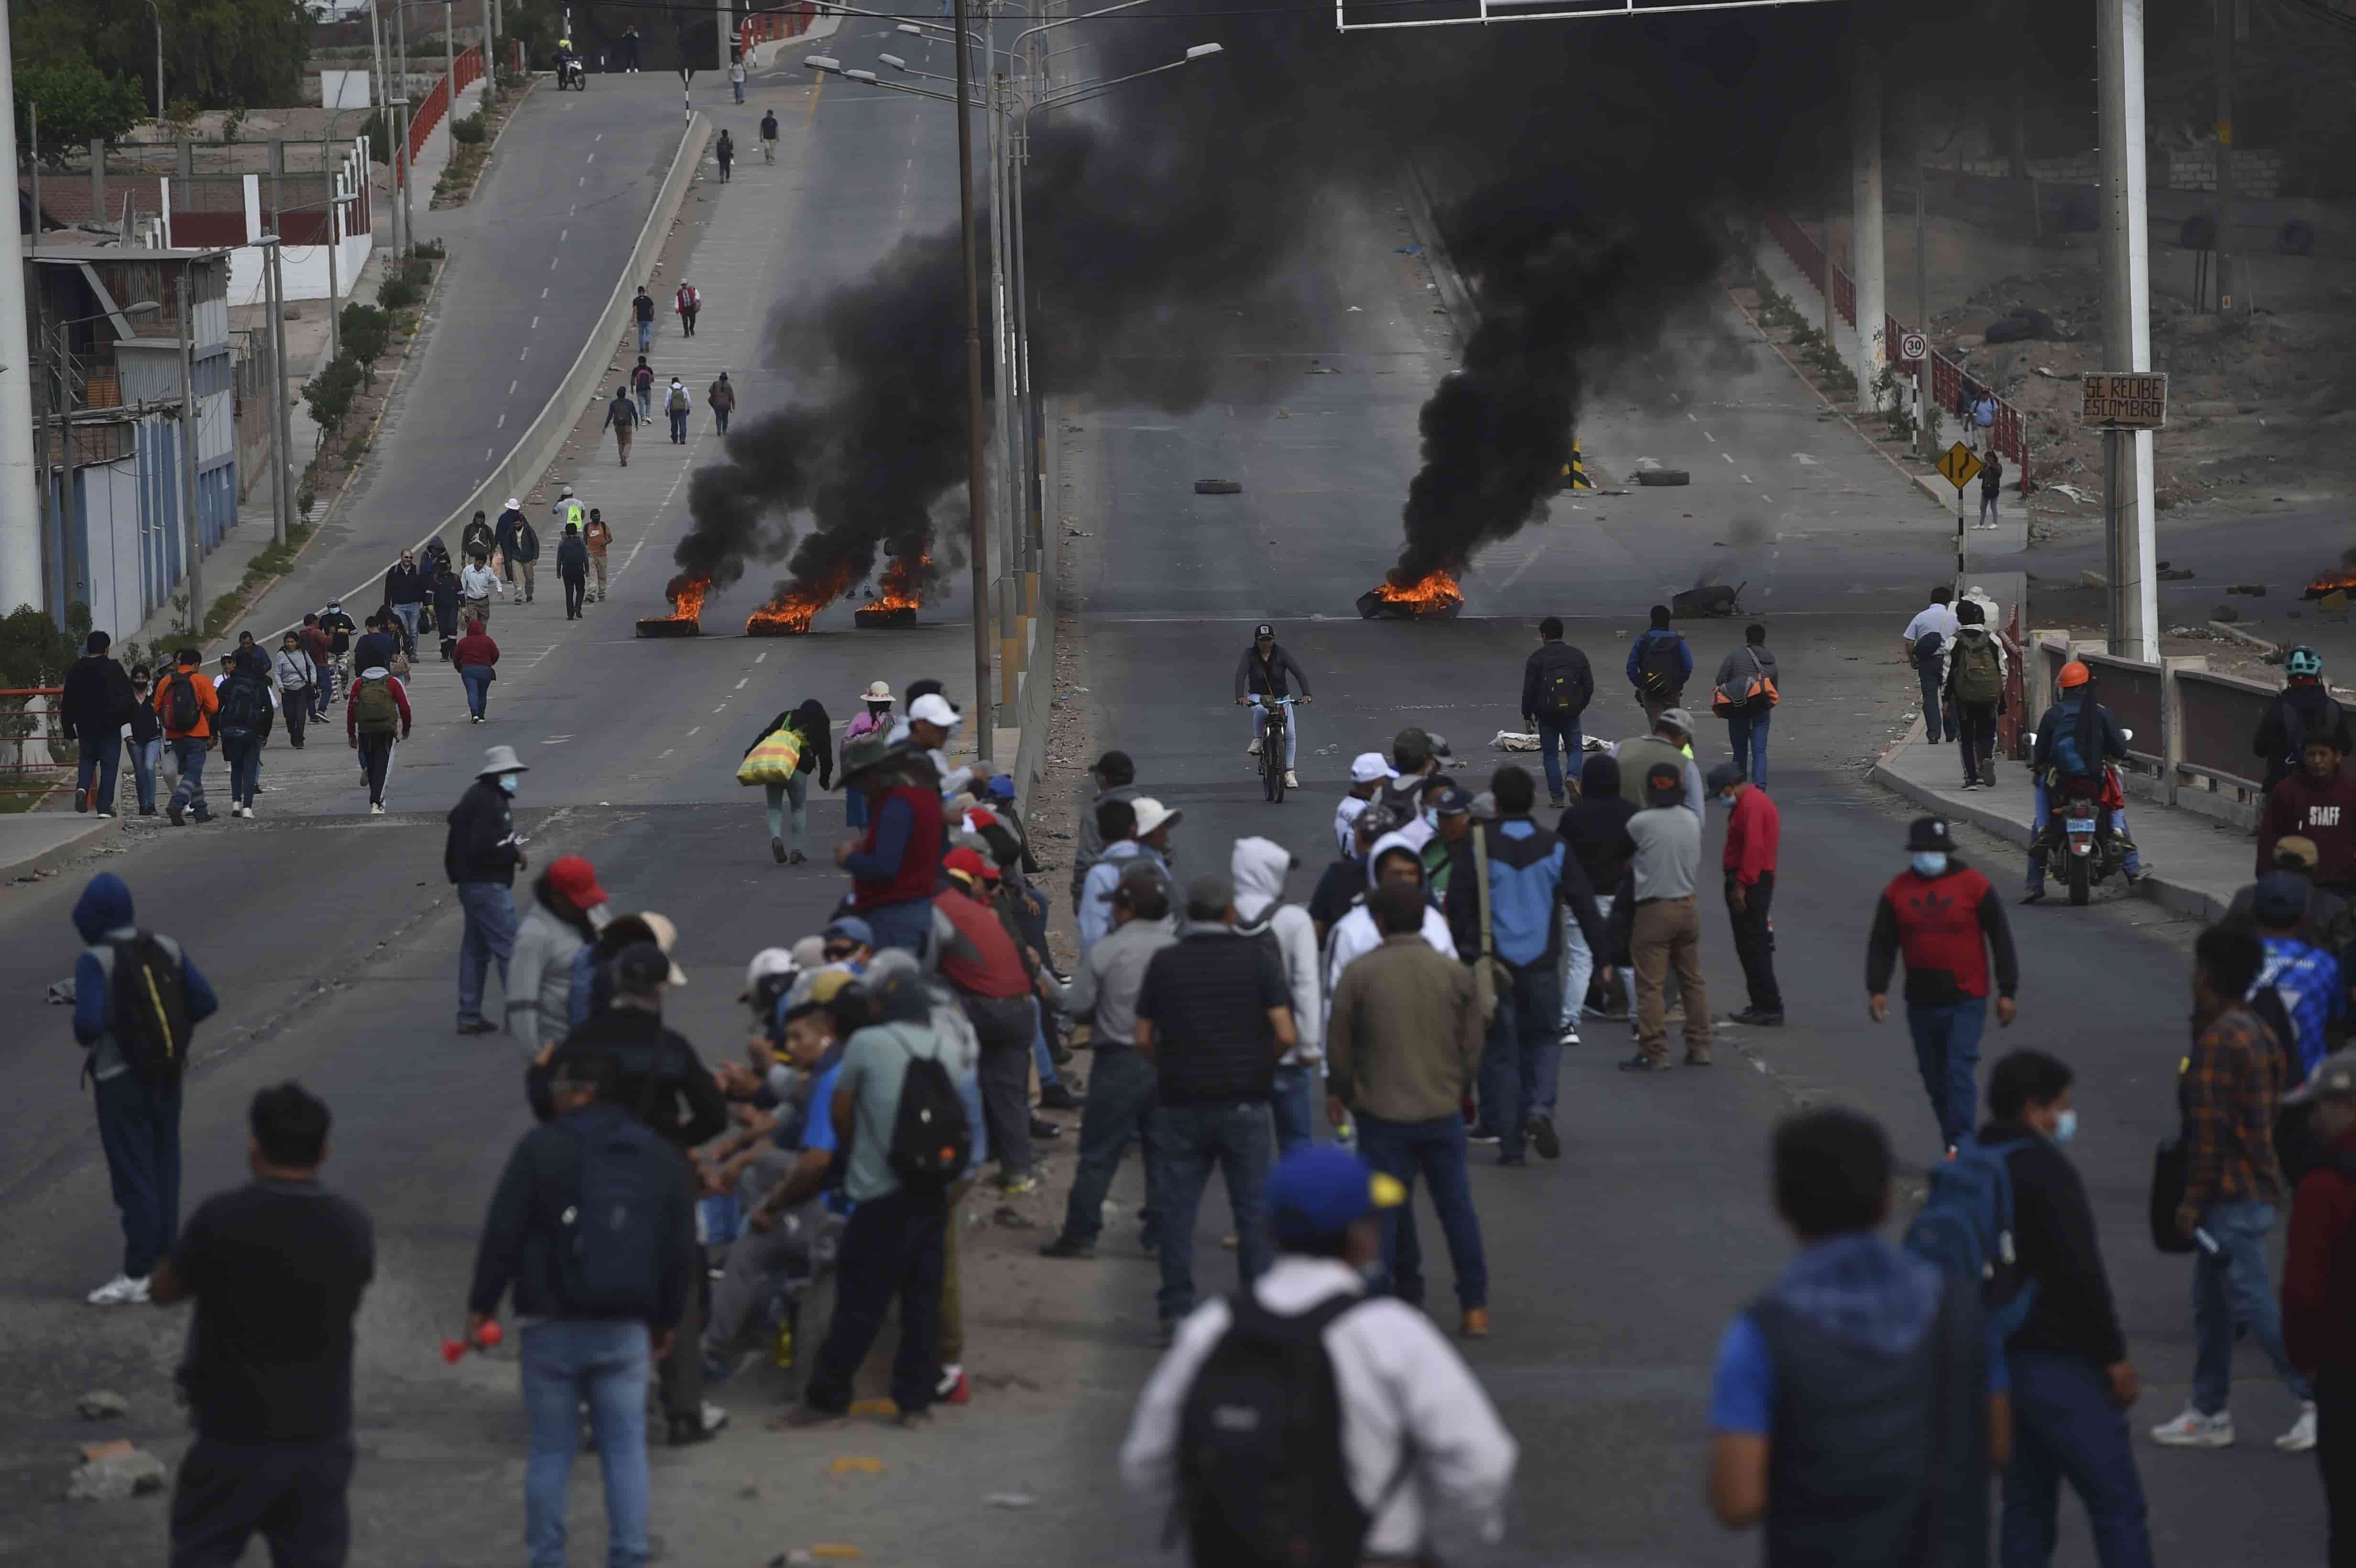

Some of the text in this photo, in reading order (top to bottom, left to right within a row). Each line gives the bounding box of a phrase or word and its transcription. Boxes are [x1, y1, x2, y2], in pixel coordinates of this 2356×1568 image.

[1908, 340, 1921, 350] 30
[2086, 377, 2162, 400] SE RECIBE
[2309, 806, 2341, 826] STAFF
